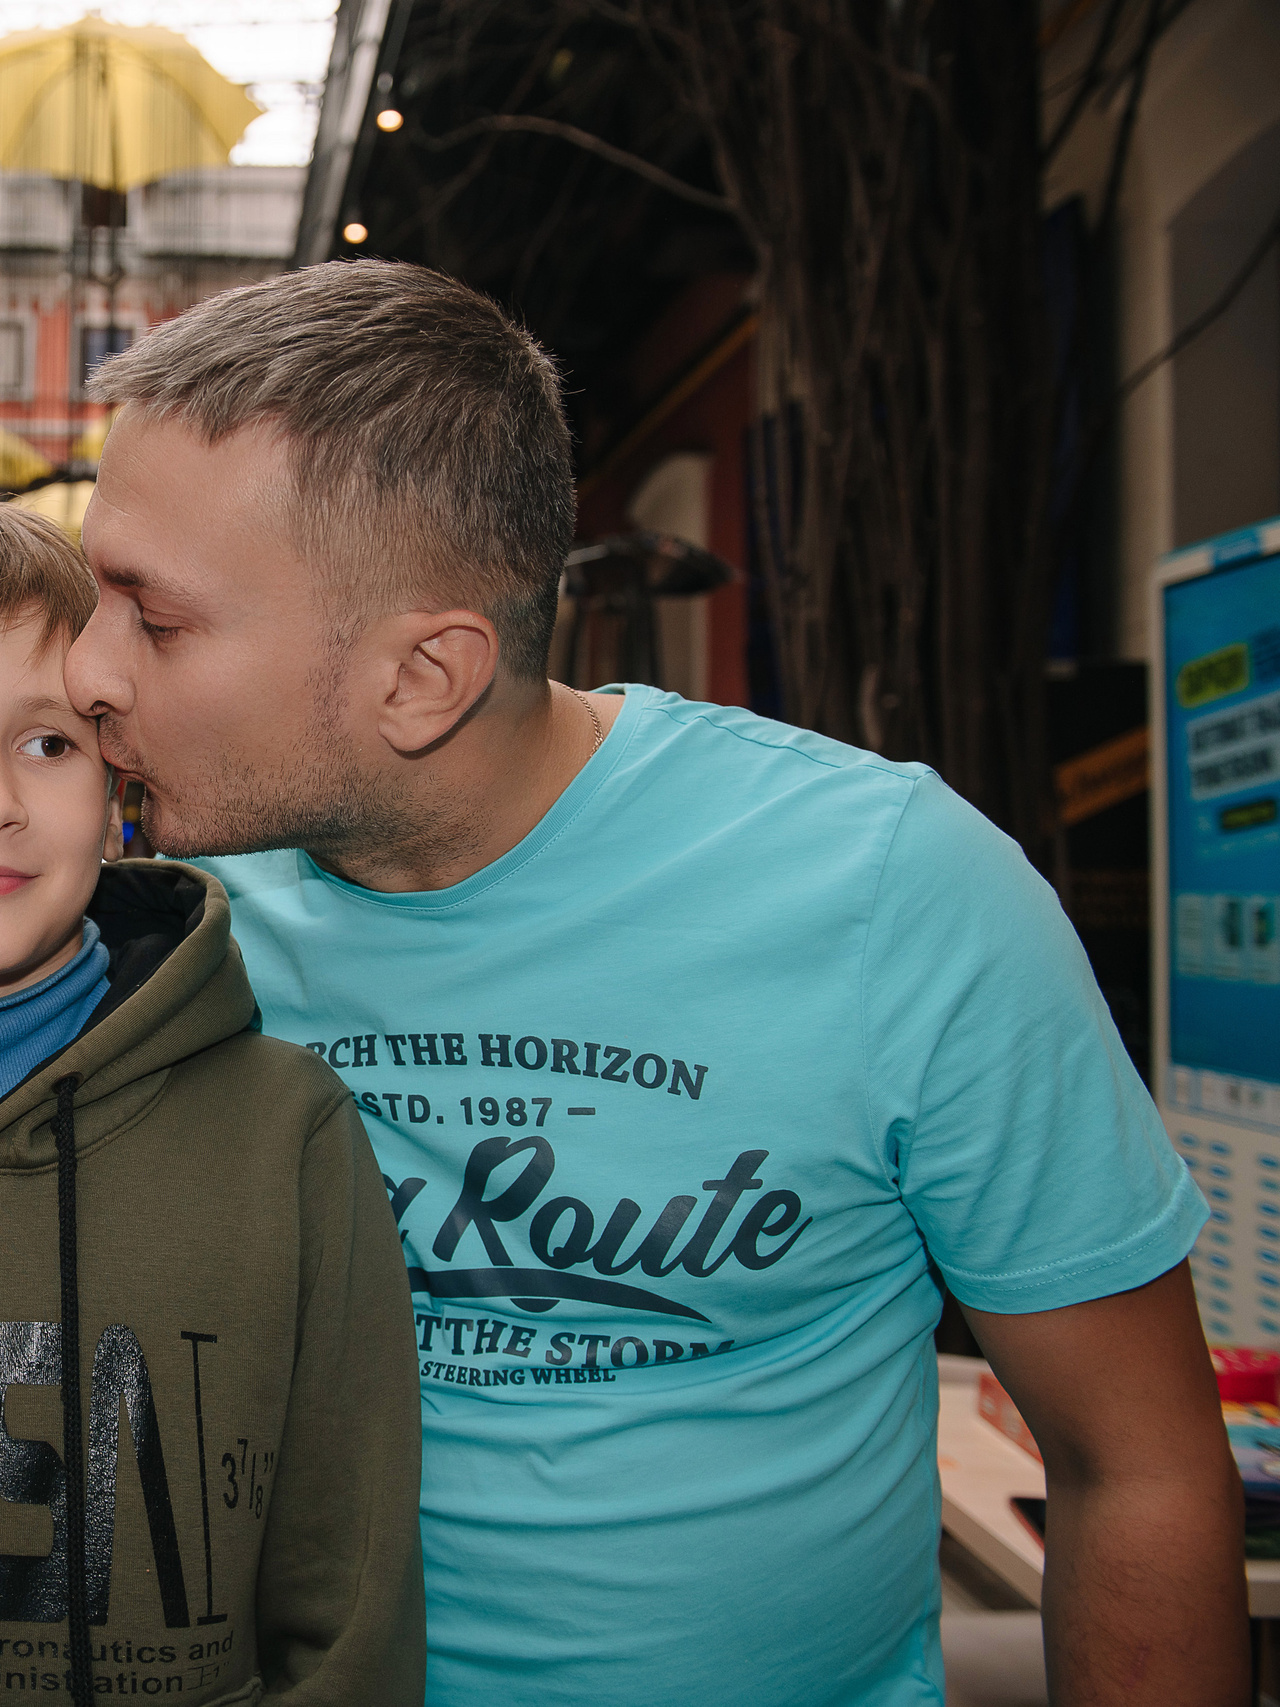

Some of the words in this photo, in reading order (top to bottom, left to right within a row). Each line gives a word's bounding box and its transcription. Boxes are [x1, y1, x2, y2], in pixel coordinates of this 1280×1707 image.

[384, 1033, 468, 1066] THE
[478, 1033, 709, 1100] HORIZON
[351, 1091, 445, 1125] STD.
[460, 1096, 553, 1127] 1987
[432, 1135, 814, 1278] Route
[444, 1317, 537, 1359] THE
[420, 1360, 526, 1387] STEERING
[530, 1367, 616, 1385] WHEEL
[188, 1630, 234, 1661] and
